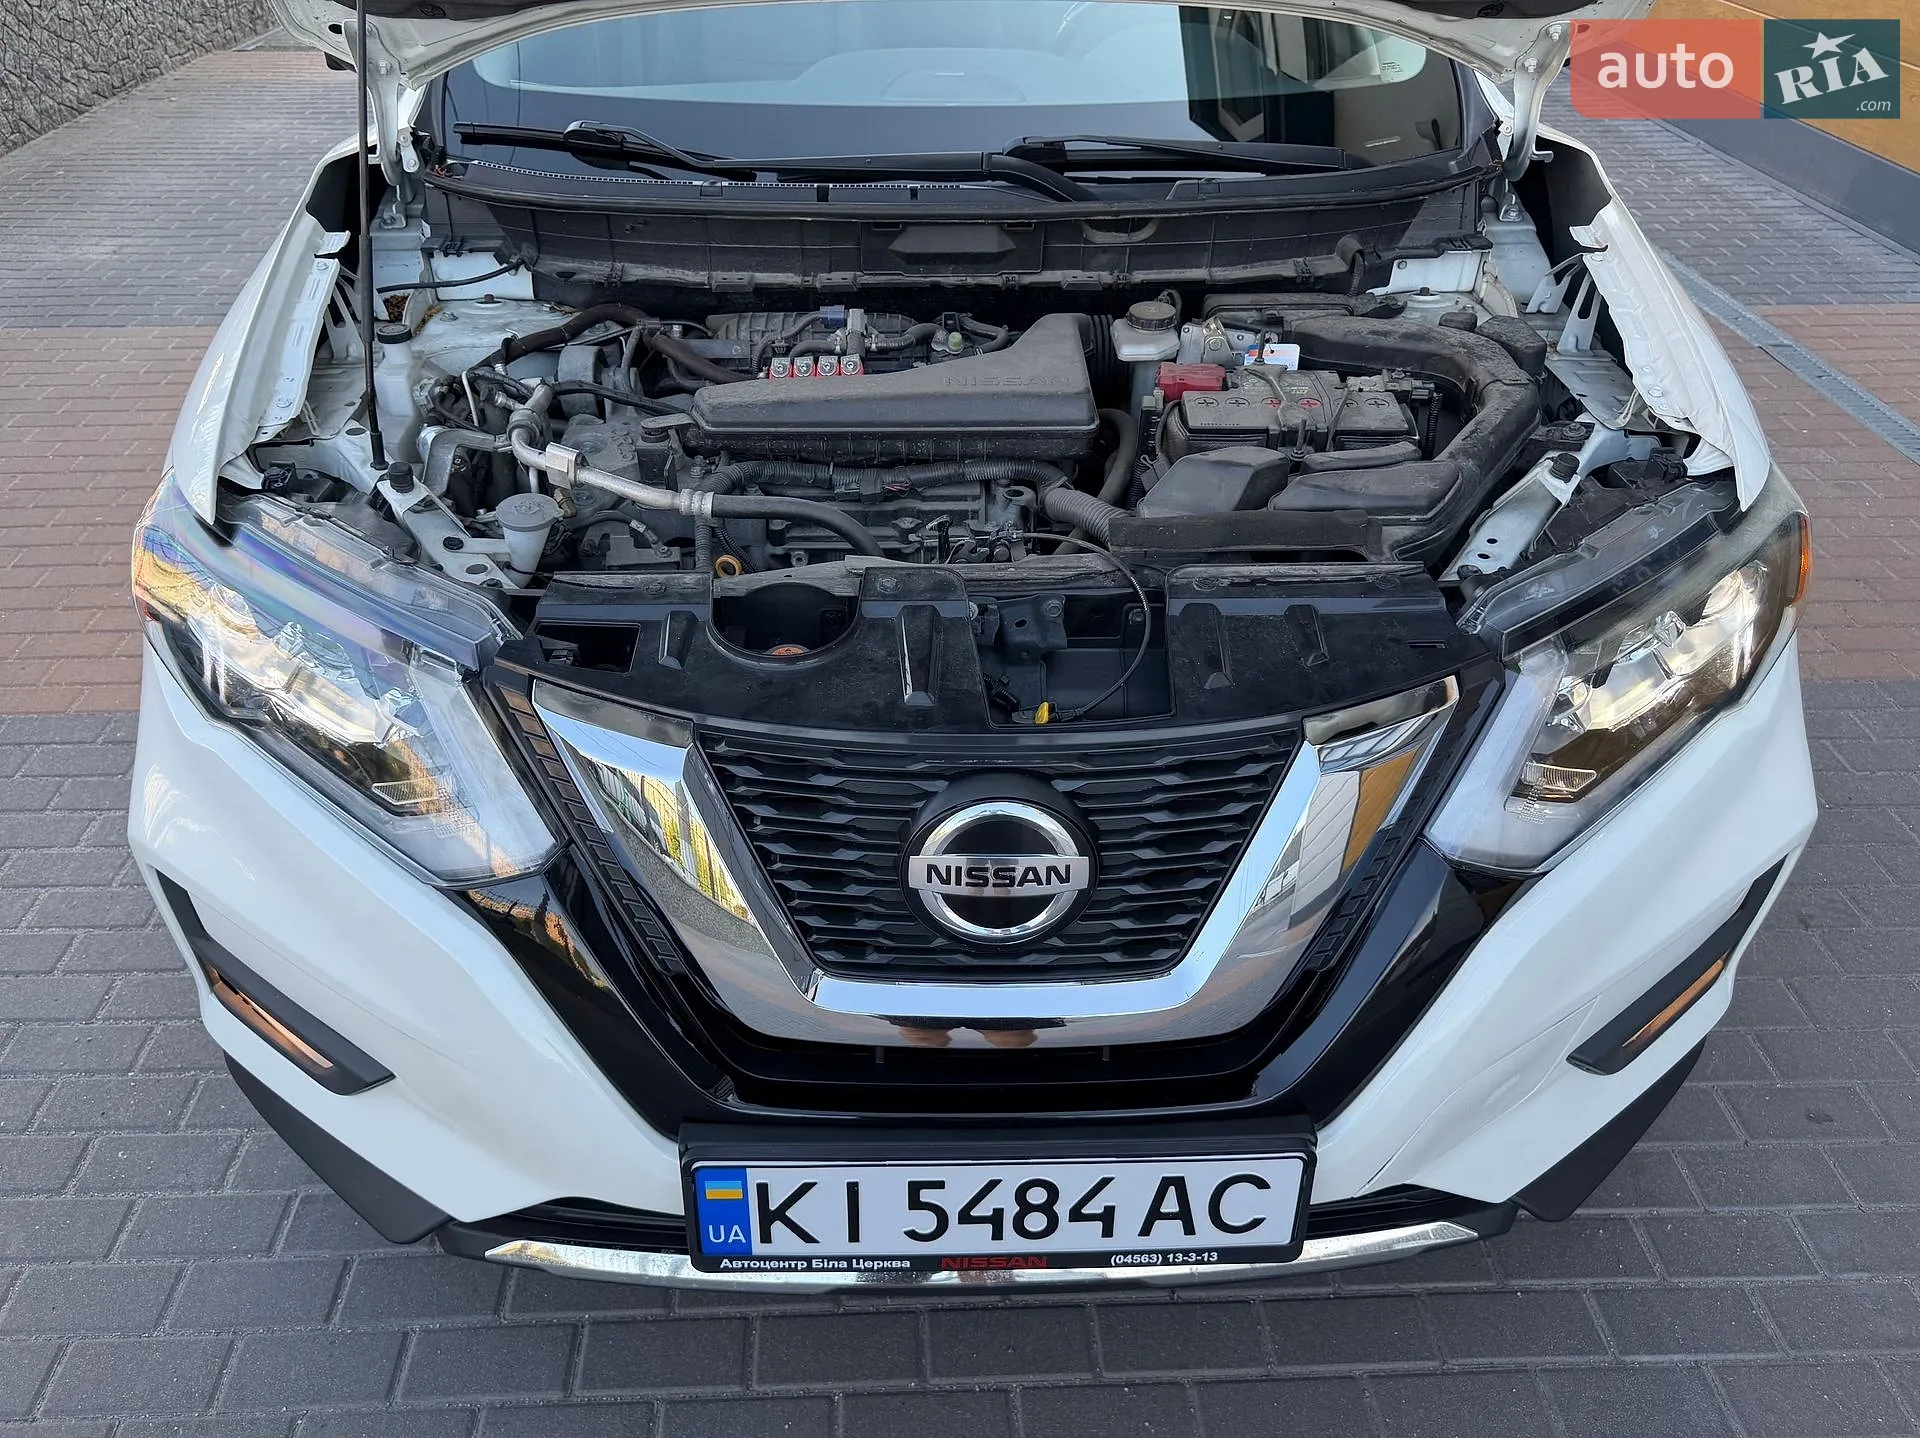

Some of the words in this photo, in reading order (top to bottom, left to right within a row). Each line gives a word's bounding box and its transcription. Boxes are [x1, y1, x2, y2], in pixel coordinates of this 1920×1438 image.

[943, 375, 1073, 387] NISSAN
[926, 863, 1071, 887] NISSAN
[902, 1176, 1116, 1243] 5484
[1137, 1172, 1272, 1238] AC
[708, 1224, 747, 1244] UA
[719, 1258, 807, 1270] Автоцентр
[811, 1258, 848, 1268] Біла
[852, 1258, 911, 1269] Церква
[940, 1255, 1047, 1269] NISSAN
[1110, 1253, 1163, 1266] (04563)
[1166, 1251, 1218, 1263] 13-3-13
